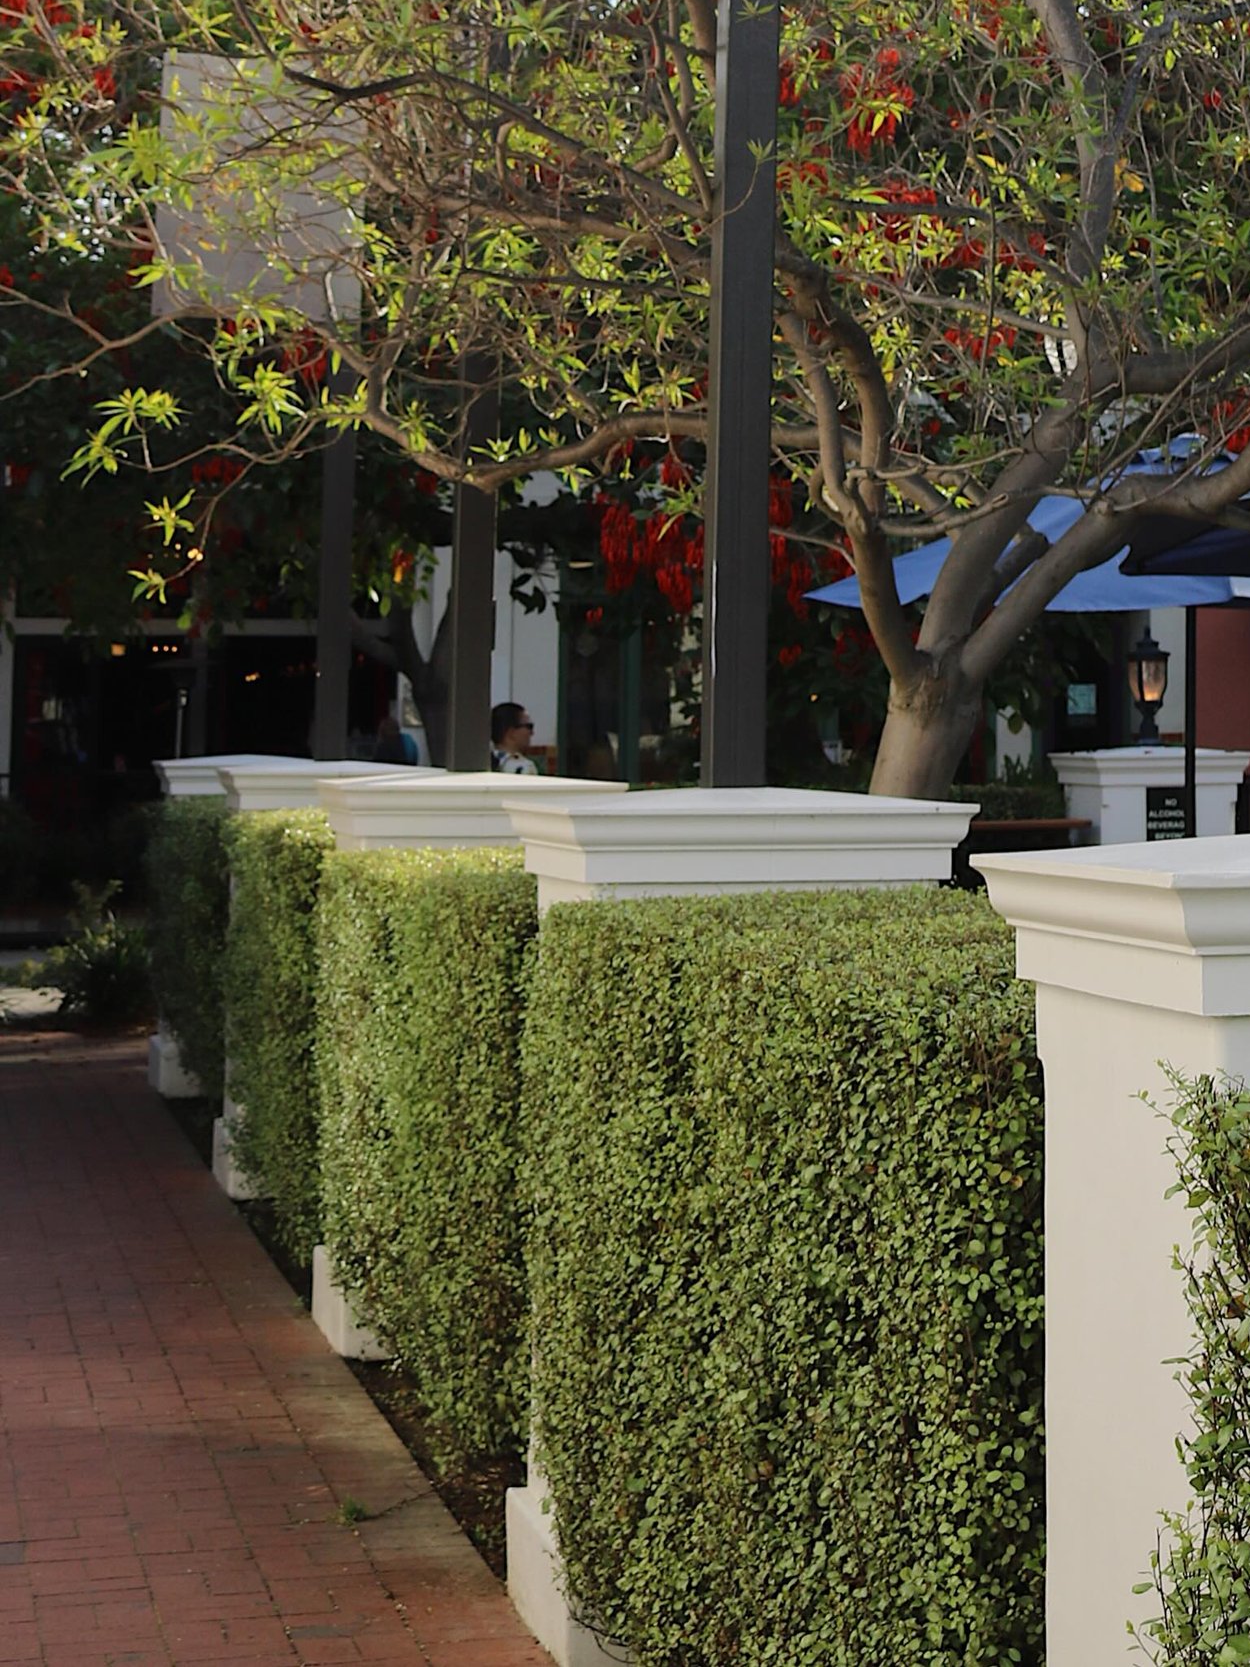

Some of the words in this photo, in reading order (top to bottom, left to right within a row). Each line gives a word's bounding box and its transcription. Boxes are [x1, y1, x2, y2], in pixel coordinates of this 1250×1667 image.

[1165, 798, 1178, 807] NO
[1149, 810, 1185, 818] ALCOHOL
[1147, 821, 1185, 829] BEVERAG
